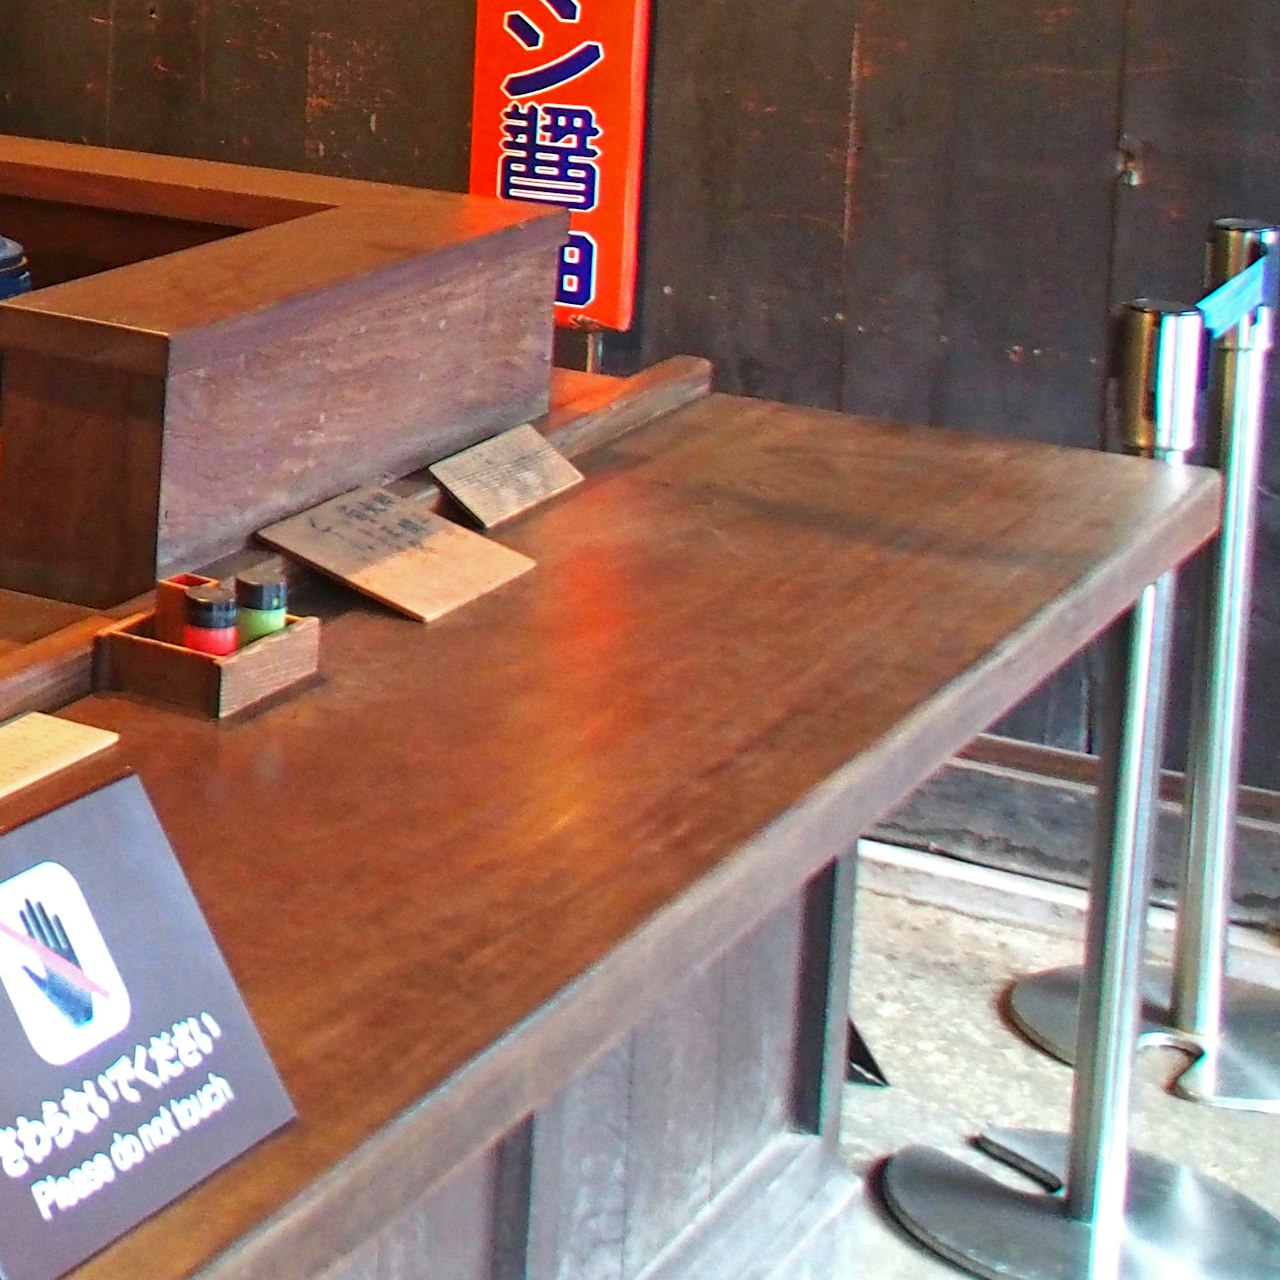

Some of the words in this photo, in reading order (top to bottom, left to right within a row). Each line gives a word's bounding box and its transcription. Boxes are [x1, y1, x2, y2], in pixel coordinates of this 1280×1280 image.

[30, 1151, 115, 1221] Please
[110, 1131, 144, 1172] do
[138, 1105, 180, 1152] not
[171, 1072, 236, 1130] touch
